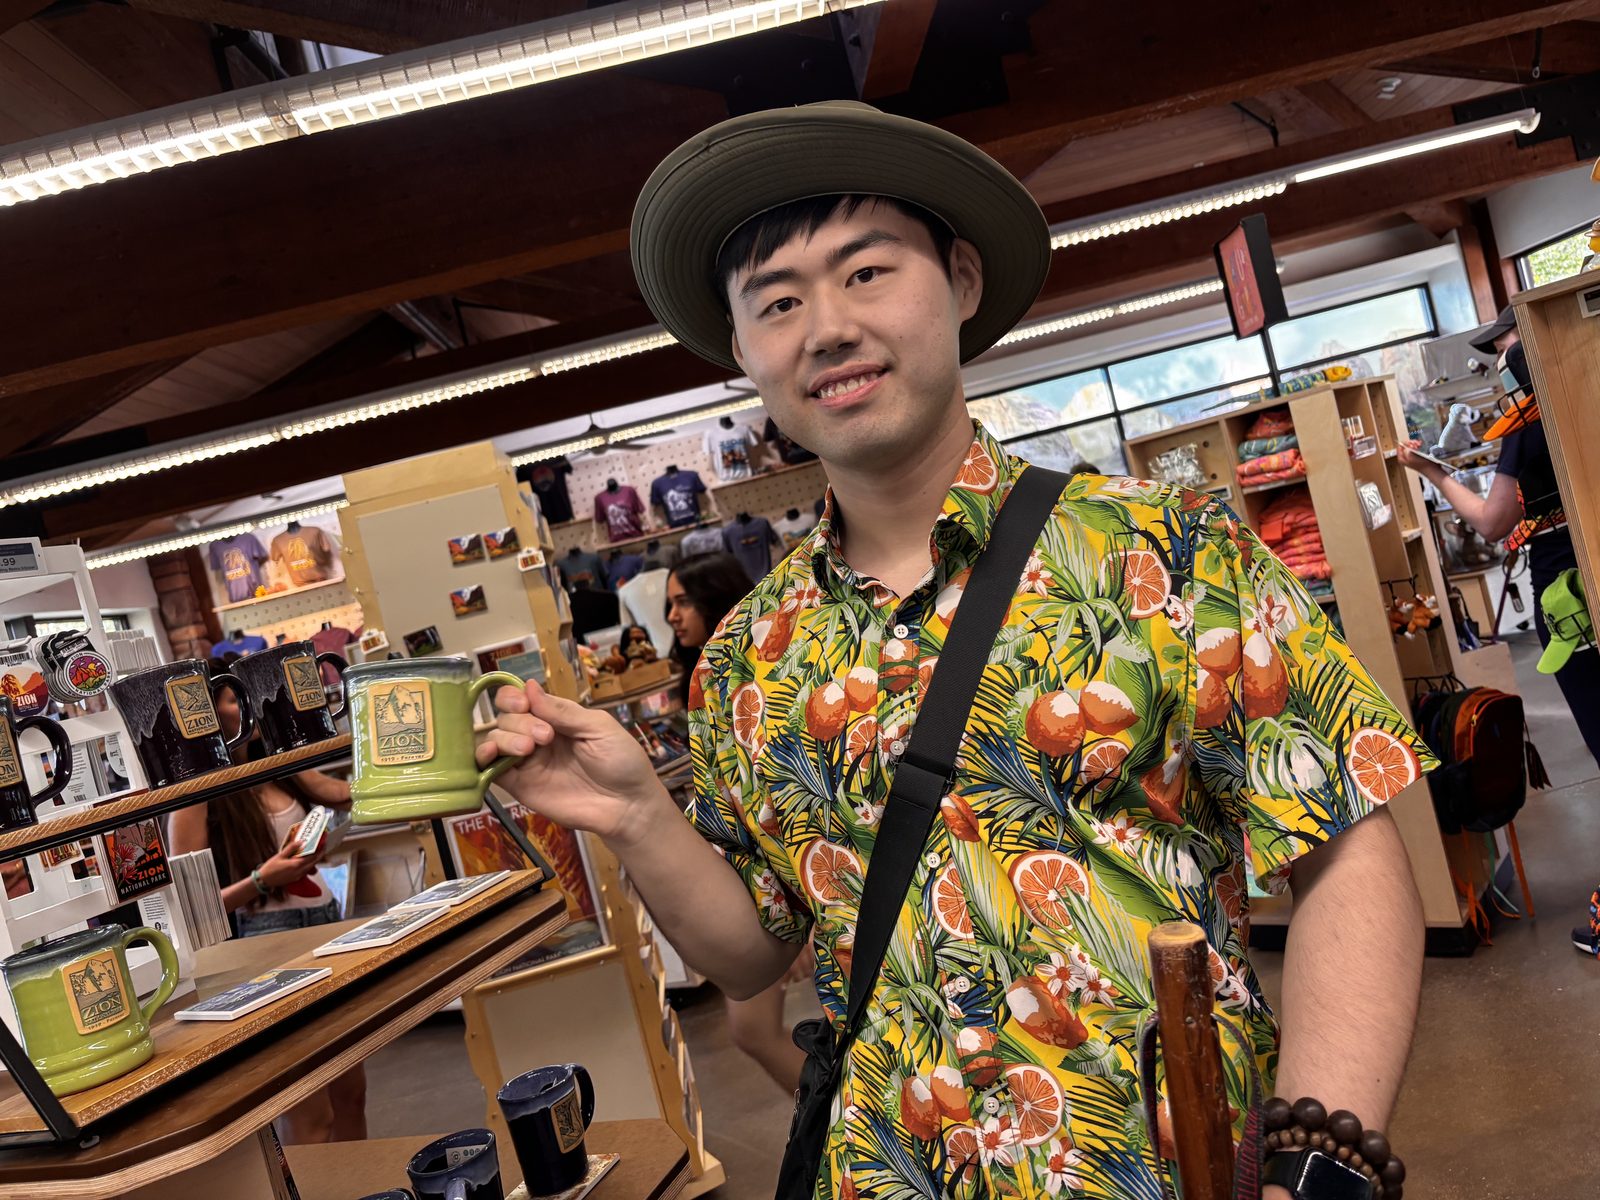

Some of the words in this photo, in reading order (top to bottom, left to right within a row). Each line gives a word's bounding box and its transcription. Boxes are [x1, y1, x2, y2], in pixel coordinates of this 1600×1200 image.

[16, 693, 37, 707] ZION
[299, 691, 321, 703] ZION
[185, 714, 213, 729] ZION
[379, 732, 426, 749] ZION
[456, 816, 485, 835] THE
[137, 864, 165, 880] ZION
[120, 880, 150, 895] NATIONAL
[151, 873, 167, 884] PARK
[81, 995, 123, 1020] ZION
